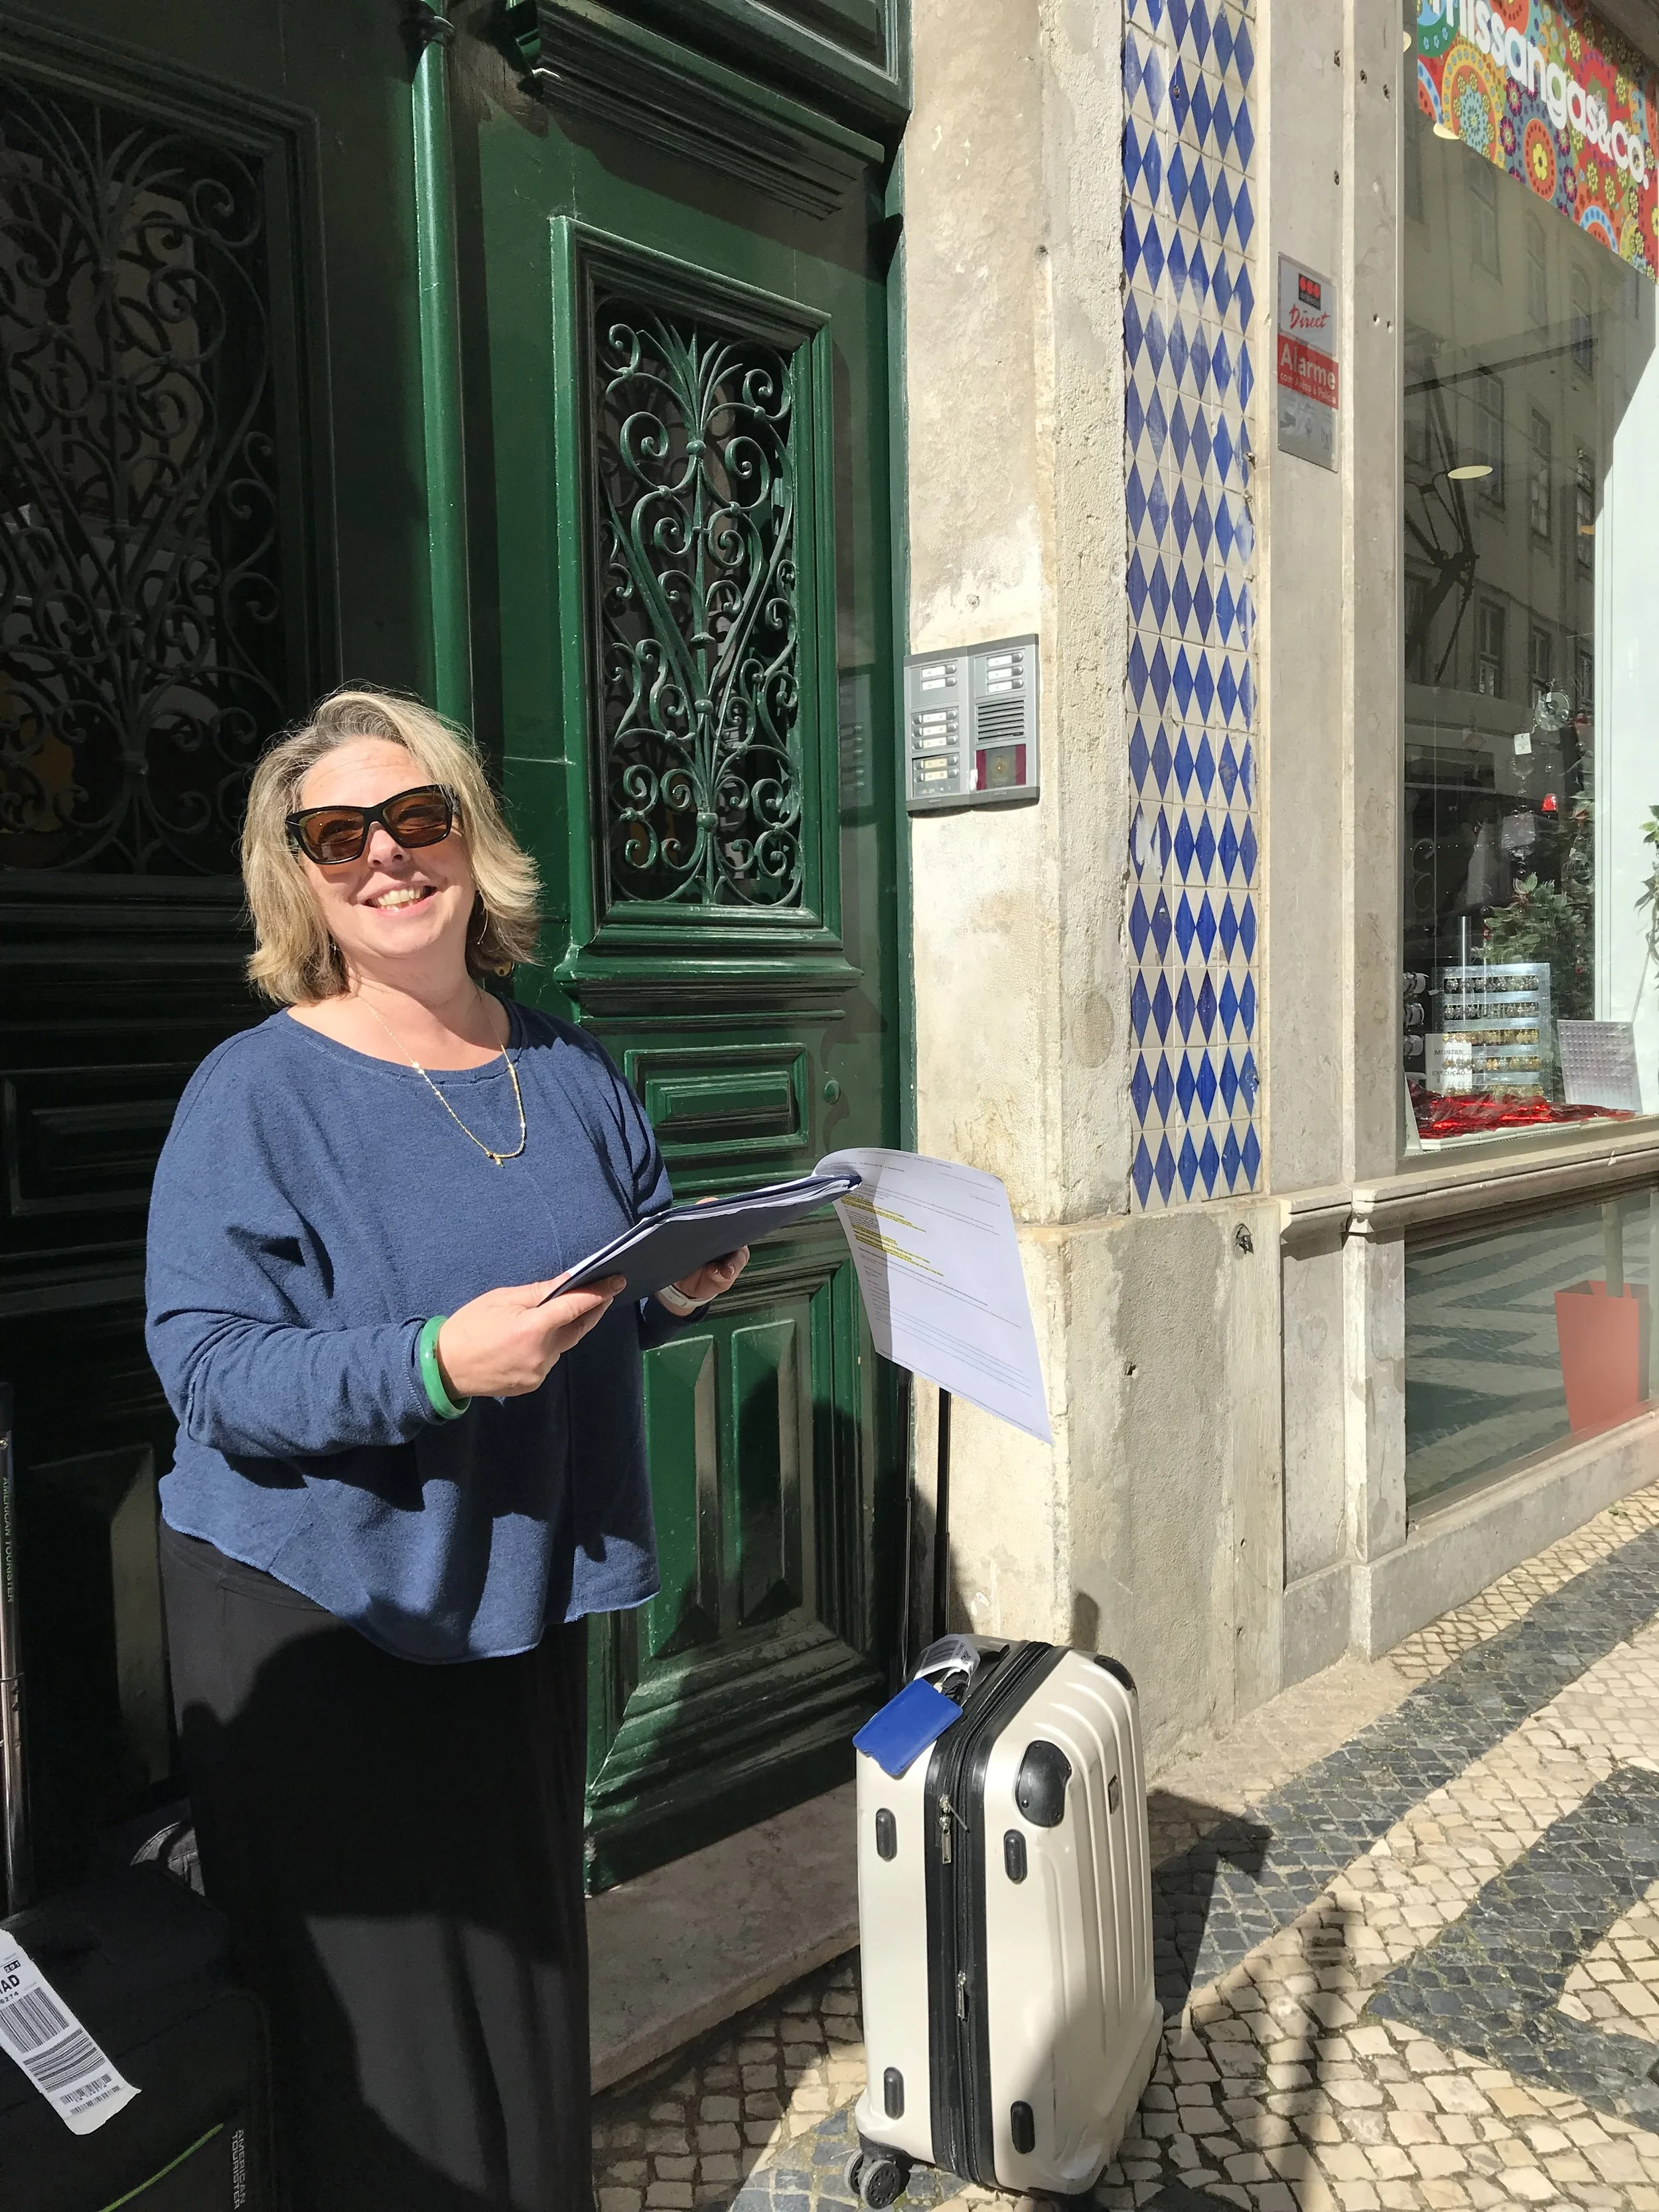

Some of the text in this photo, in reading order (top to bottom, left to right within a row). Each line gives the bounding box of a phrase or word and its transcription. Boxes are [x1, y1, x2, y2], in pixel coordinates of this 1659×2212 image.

[1289, 303, 1331, 329] Direct
[1280, 343, 1336, 390] Alarme
[3, 1477, 15, 1603] AMERICAN TOURISTER
[0, 1974, 21, 1994] AD
